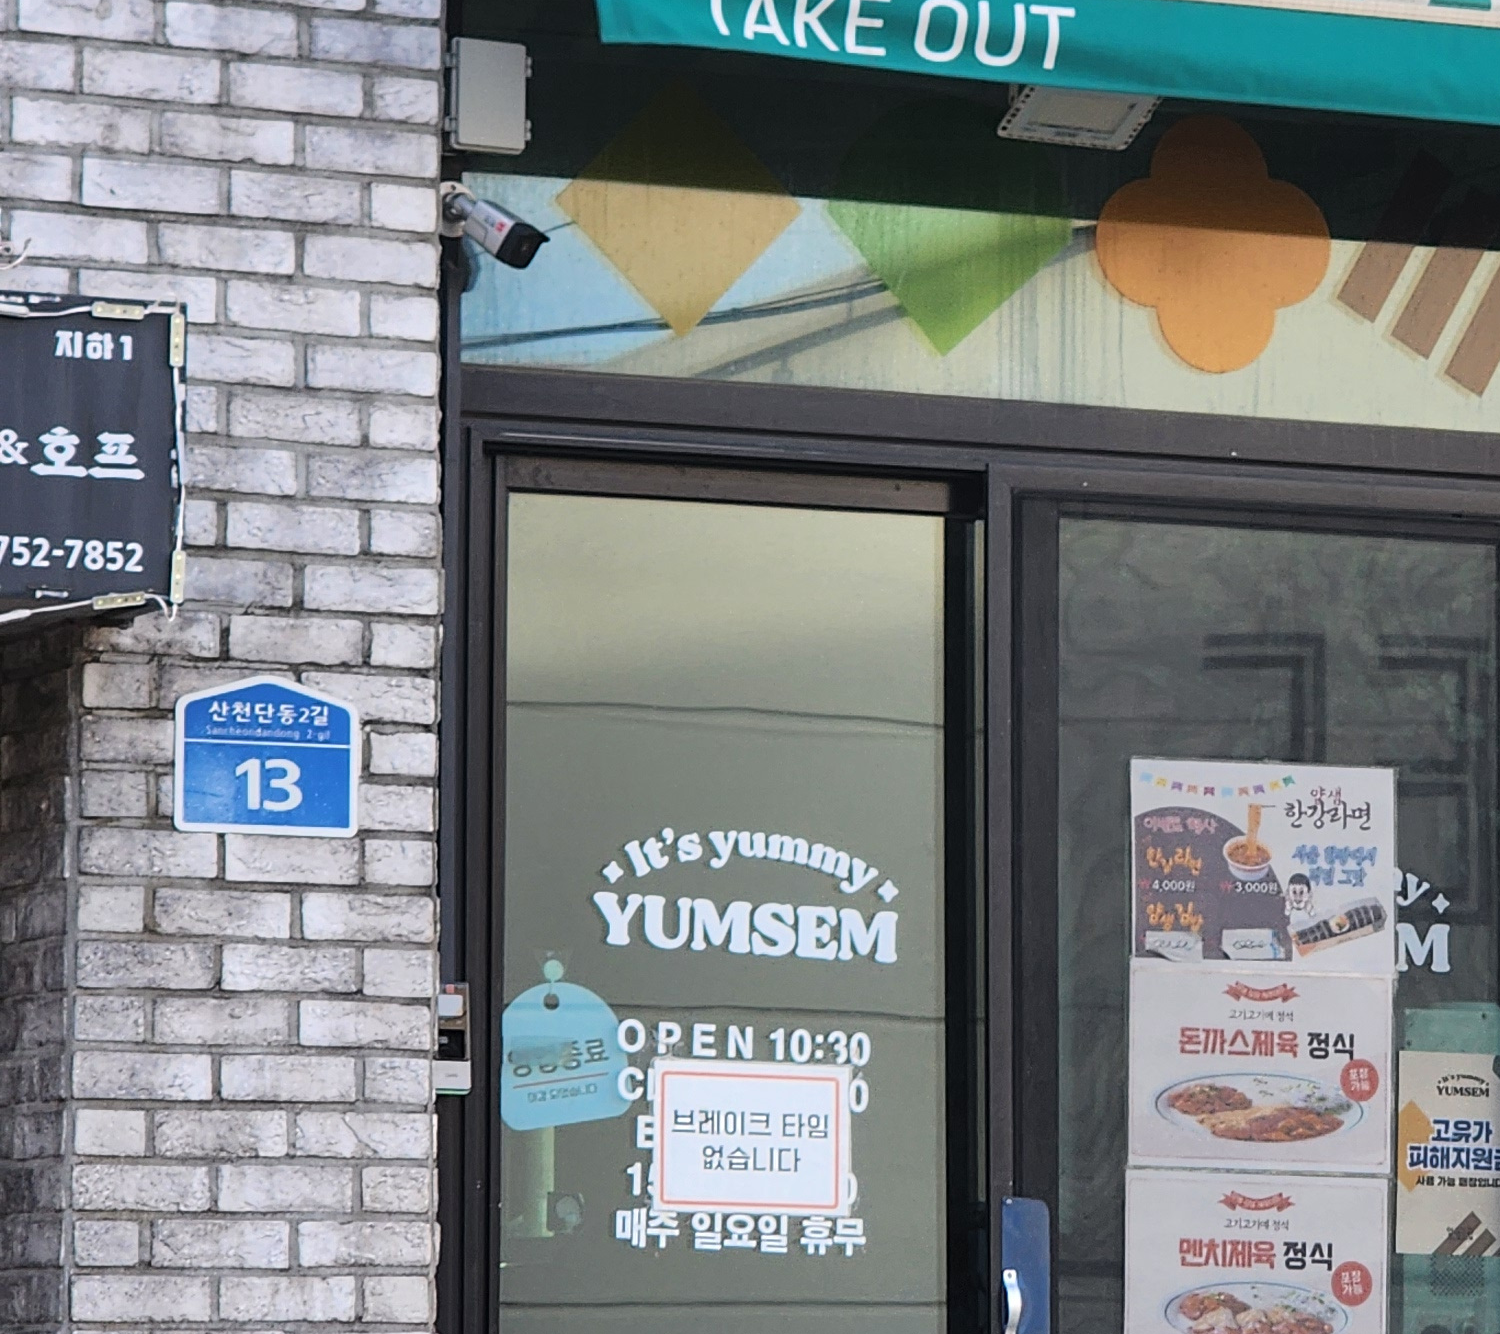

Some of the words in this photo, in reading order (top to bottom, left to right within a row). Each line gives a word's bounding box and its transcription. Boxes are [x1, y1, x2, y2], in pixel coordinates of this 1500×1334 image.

[55, 330, 132, 361] 지하1
[208, 700, 329, 727] 산천단동2길
[235, 757, 303, 812] 13
[1284, 799, 1371, 831] 한강라면
[624, 828, 702, 877] It's
[709, 830, 878, 894] yummy
[593, 891, 899, 964] YUMSEM
[617, 1019, 754, 1060] OPEN
[769, 1028, 871, 1066] 10:30
[1179, 1027, 1299, 1059] 돈까스제육
[1307, 1032, 1354, 1061] 정식
[1436, 1086, 1490, 1098] YUMSEM
[671, 1109, 773, 1137] 브레이크
[781, 1112, 829, 1140] 타임
[1432, 1119, 1492, 1144] 고유가
[702, 1147, 801, 1174] 없습니다
[615, 1208, 680, 1249] 매주
[692, 1213, 788, 1254] 일요일
[801, 1216, 866, 1257] 휴무
[1179, 1238, 1276, 1270] 멘치제육
[1283, 1242, 1333, 1271] 정식
